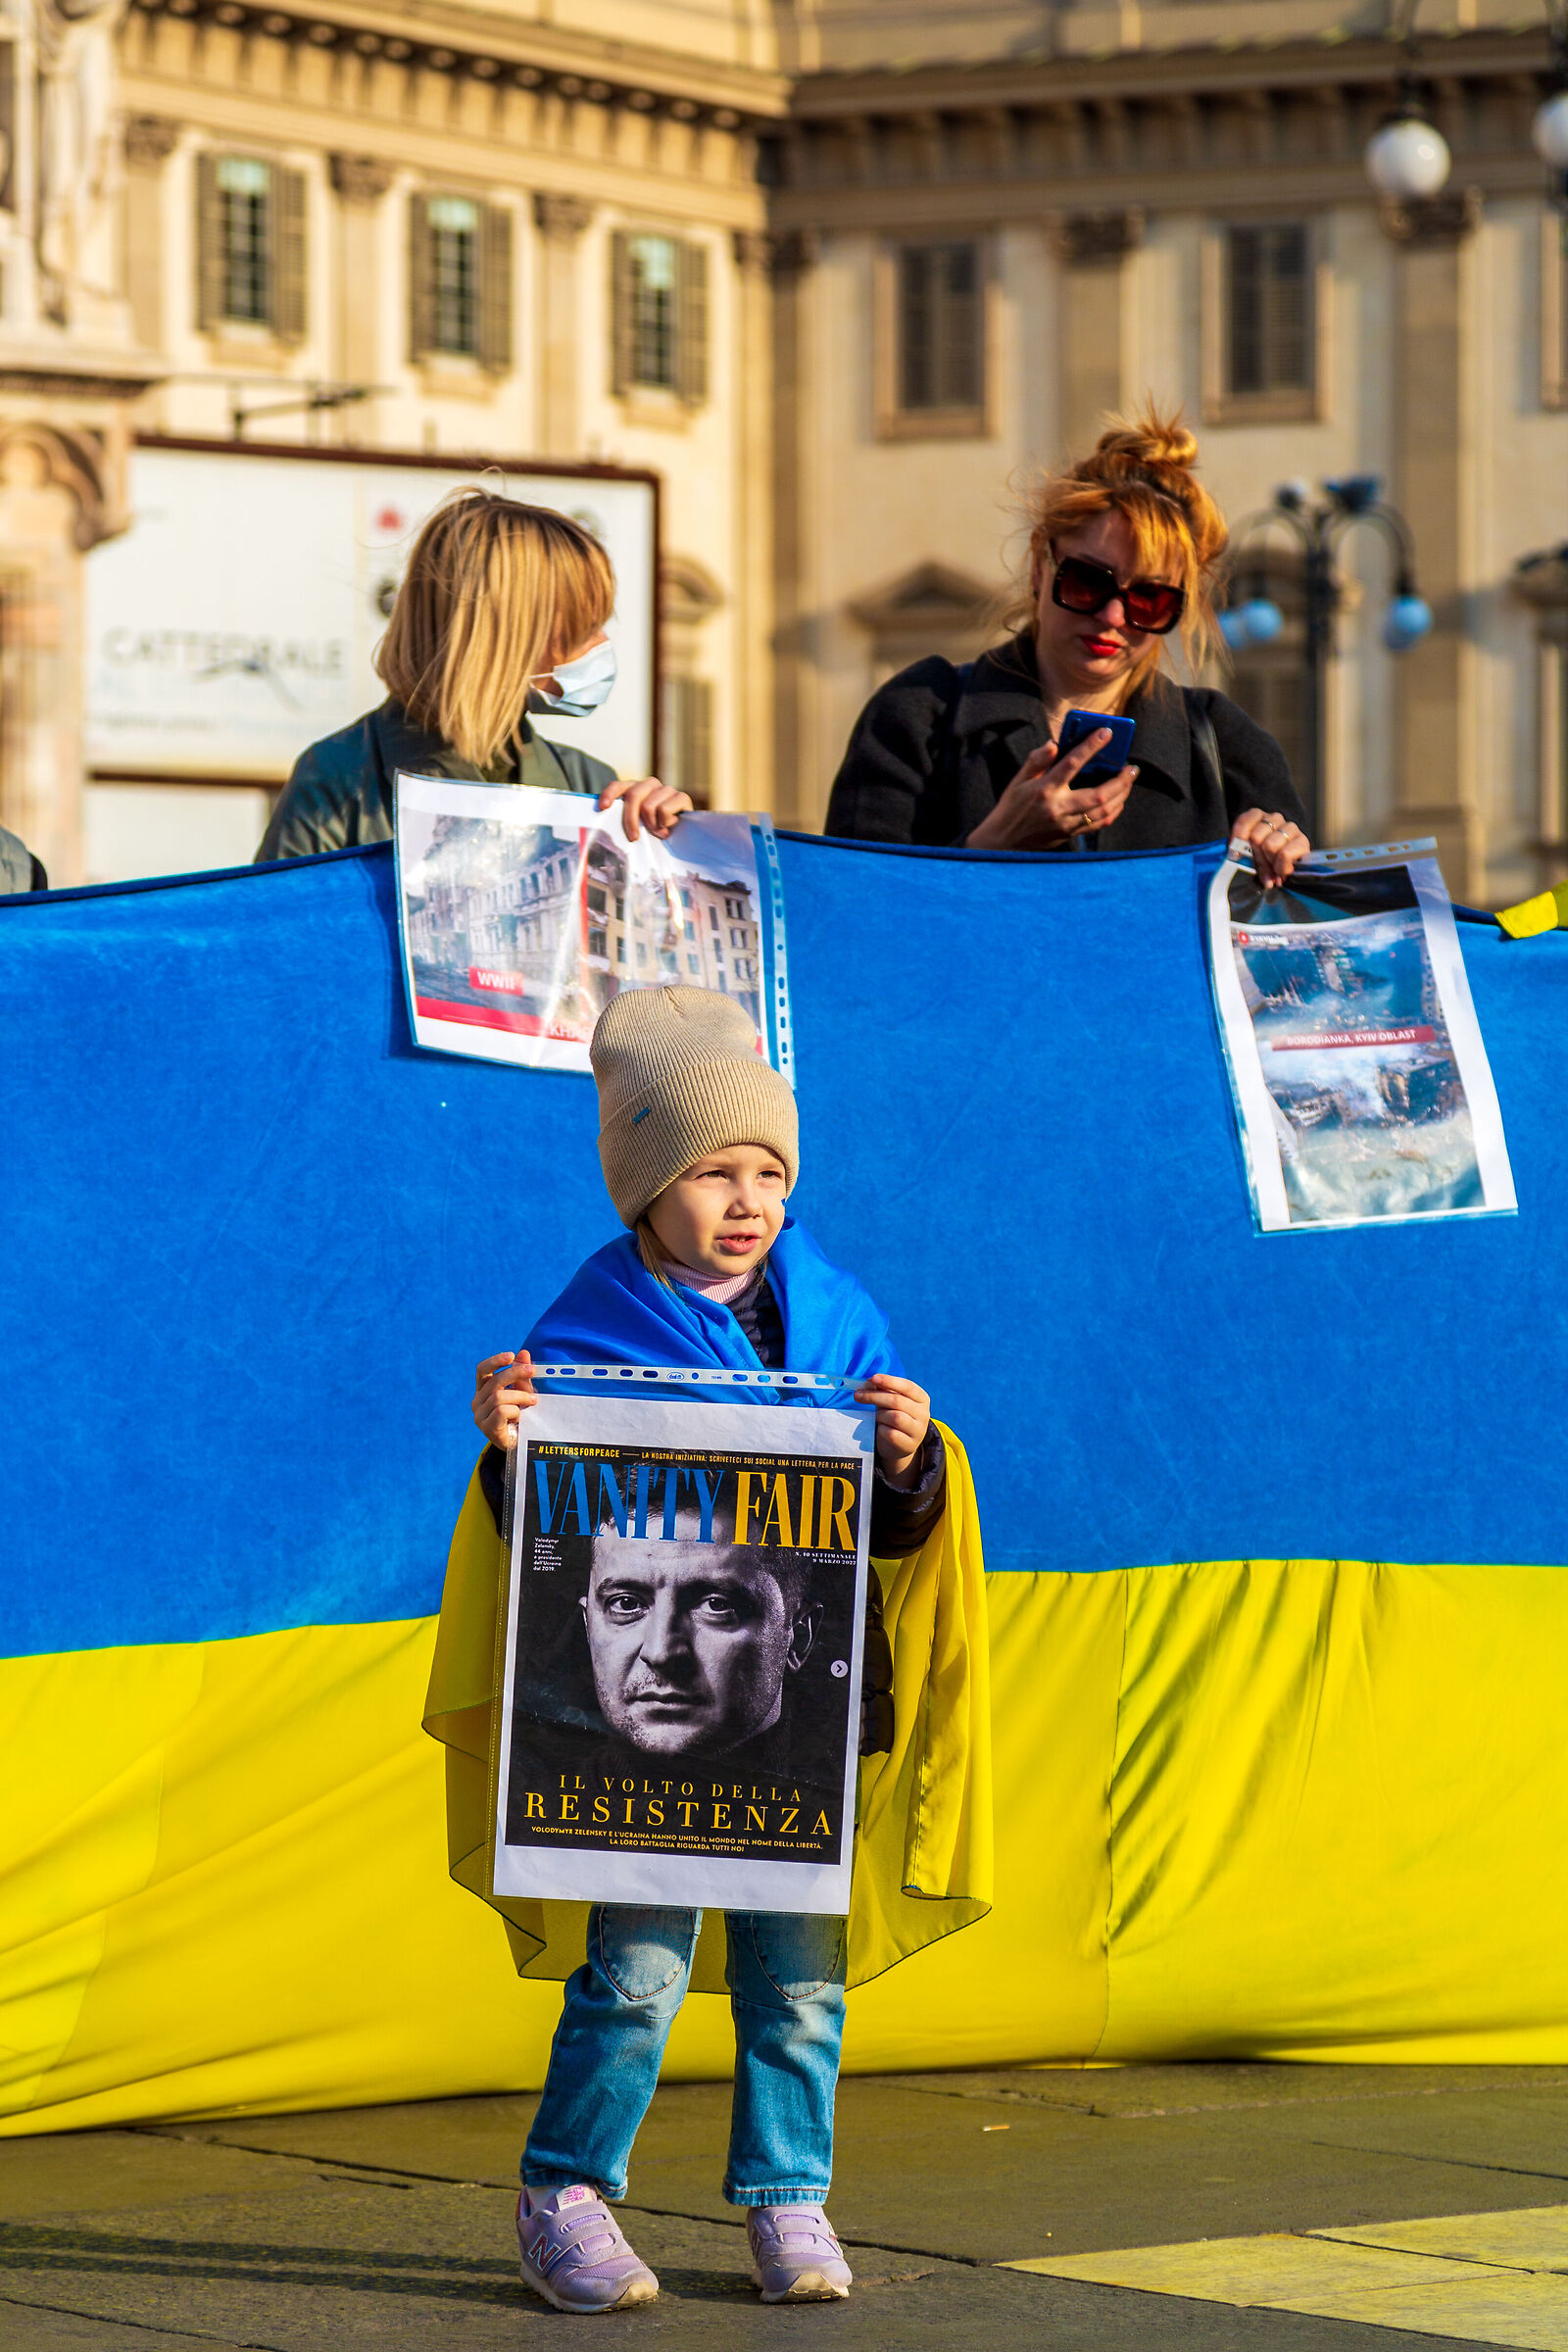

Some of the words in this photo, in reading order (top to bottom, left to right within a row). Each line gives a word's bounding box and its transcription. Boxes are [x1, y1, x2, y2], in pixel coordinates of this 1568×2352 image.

[476, 970, 515, 990] WWII
[1354, 1032, 1377, 1043] KYIV
[1379, 1029, 1417, 1042] OBLAST
[538, 1446, 620, 1458] #LETTERSFORPEACE
[675, 1453, 708, 1462] INIZIATIVA:
[755, 1457, 775, 1466] SOCIAL
[791, 1459, 816, 1468] LETTERA
[532, 1460, 726, 1544] VANITY
[731, 1471, 858, 1551] FAIR
[560, 1774, 585, 1789] IL
[604, 1777, 694, 1796] VOLTO
[711, 1784, 801, 1802] DELLA
[523, 1792, 834, 1837] RESISTENZA
[531, 1826, 573, 1836] VOLODYMYR
[574, 1829, 608, 1838] ZELENSKY
[640, 1840, 675, 1849] BATTAGLIA
[528, 2233, 562, 2272] N
